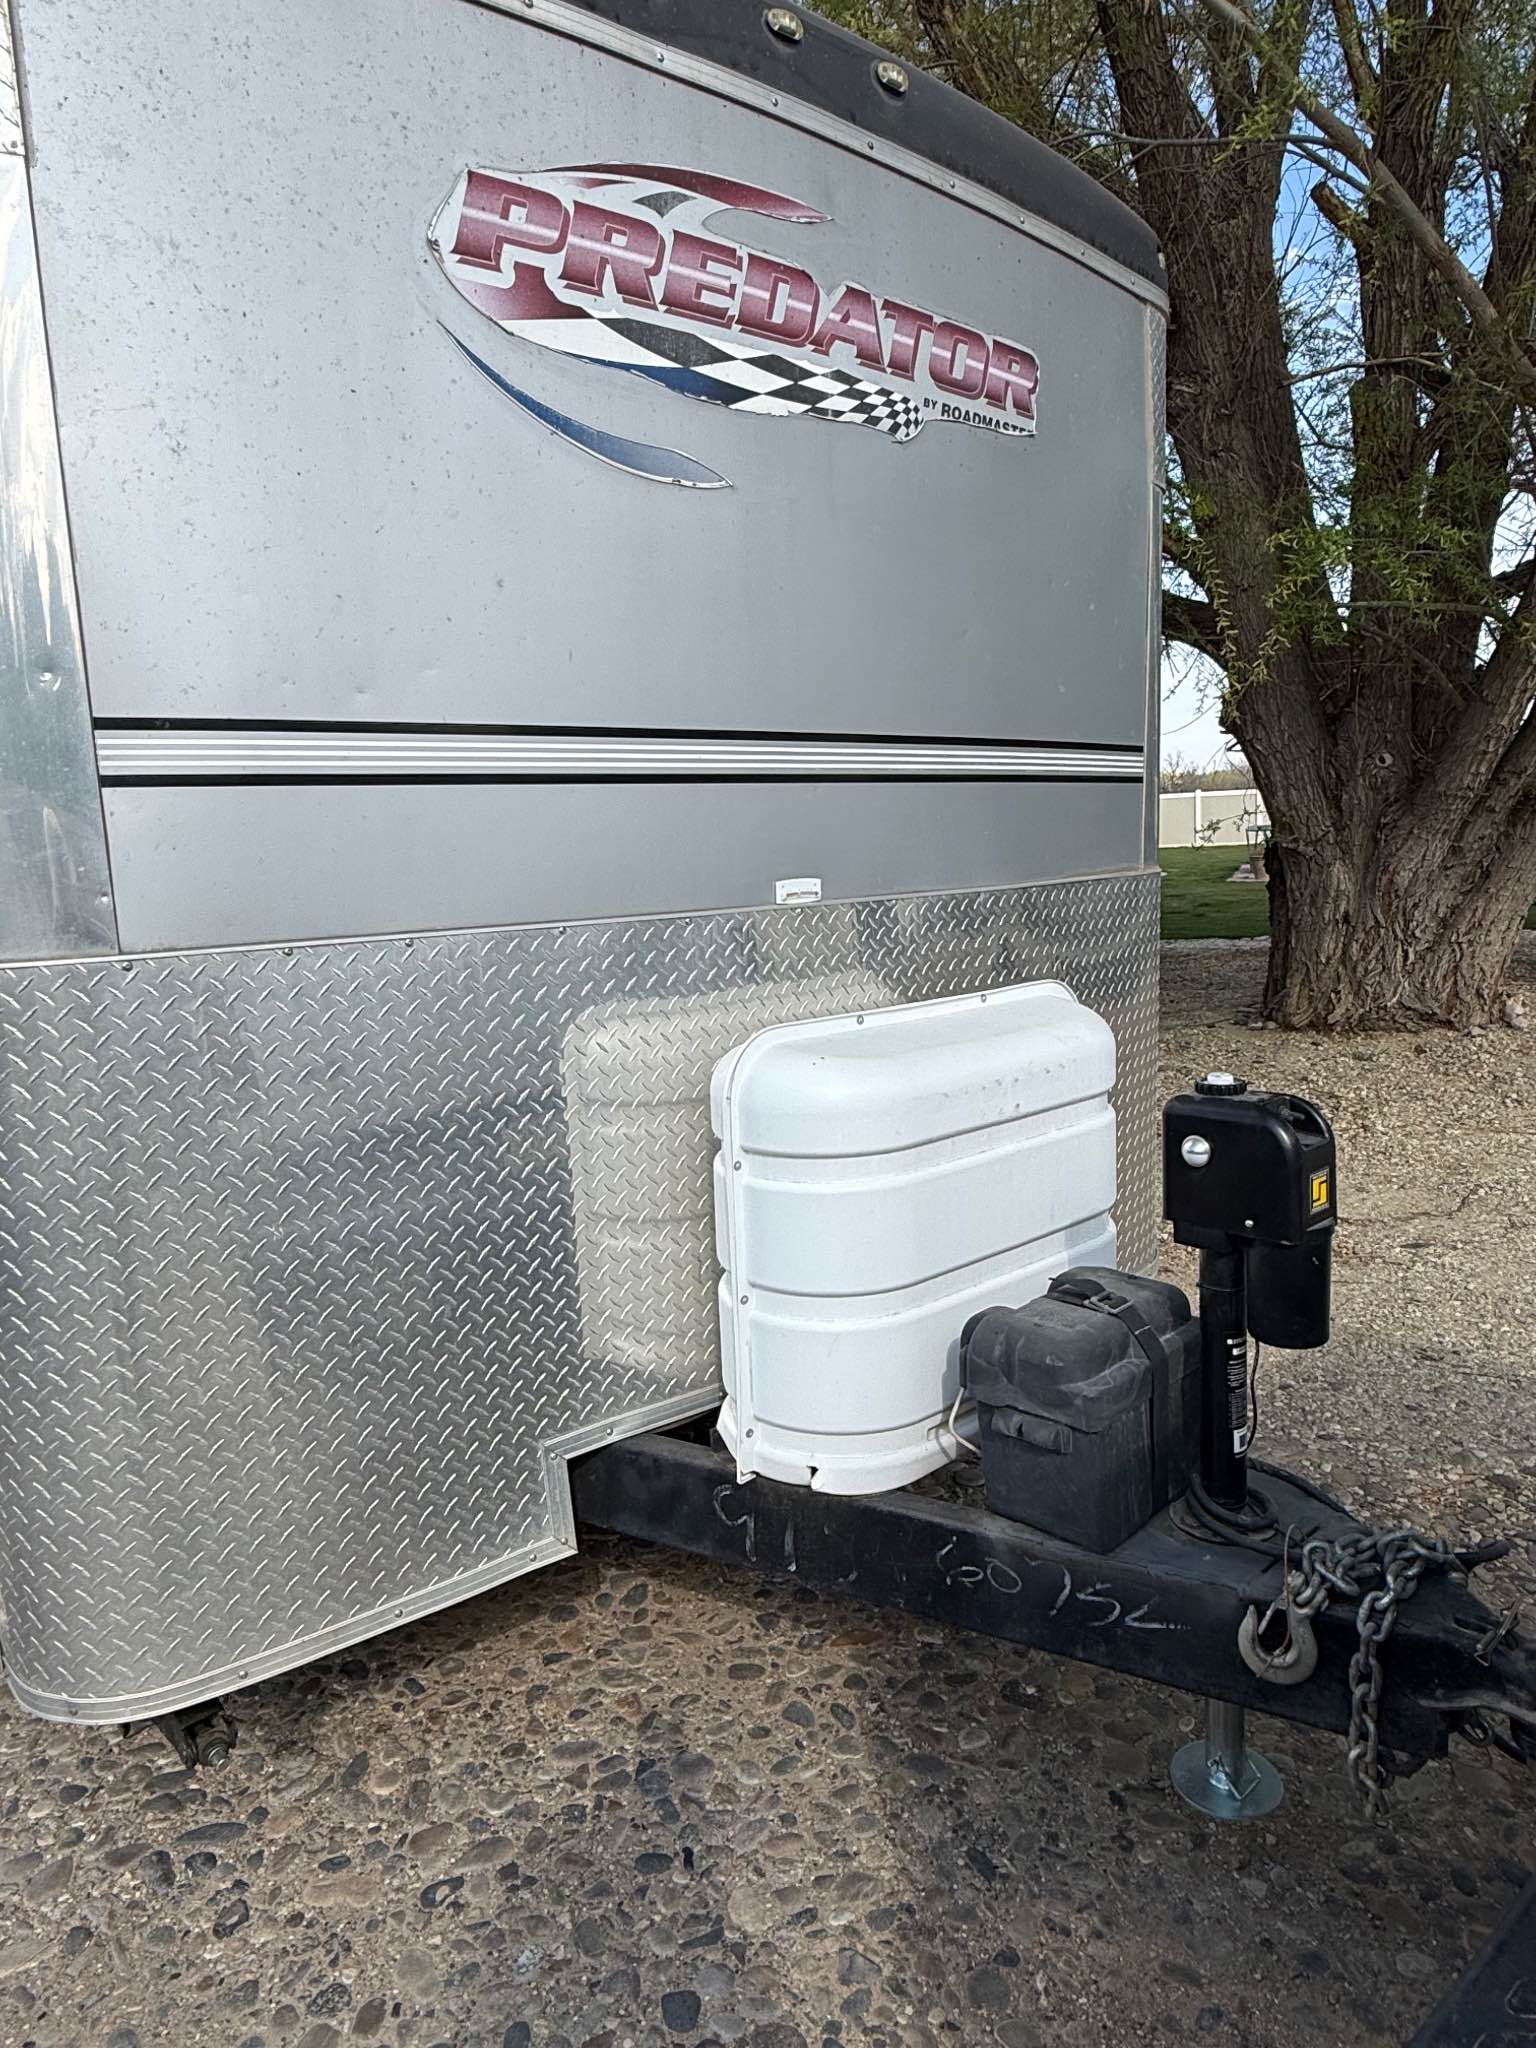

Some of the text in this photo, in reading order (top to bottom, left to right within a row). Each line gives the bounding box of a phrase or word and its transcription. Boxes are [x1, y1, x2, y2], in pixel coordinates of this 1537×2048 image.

[449, 168, 1038, 420] PREDATOR
[923, 397, 1035, 434] BY ROADMAST
